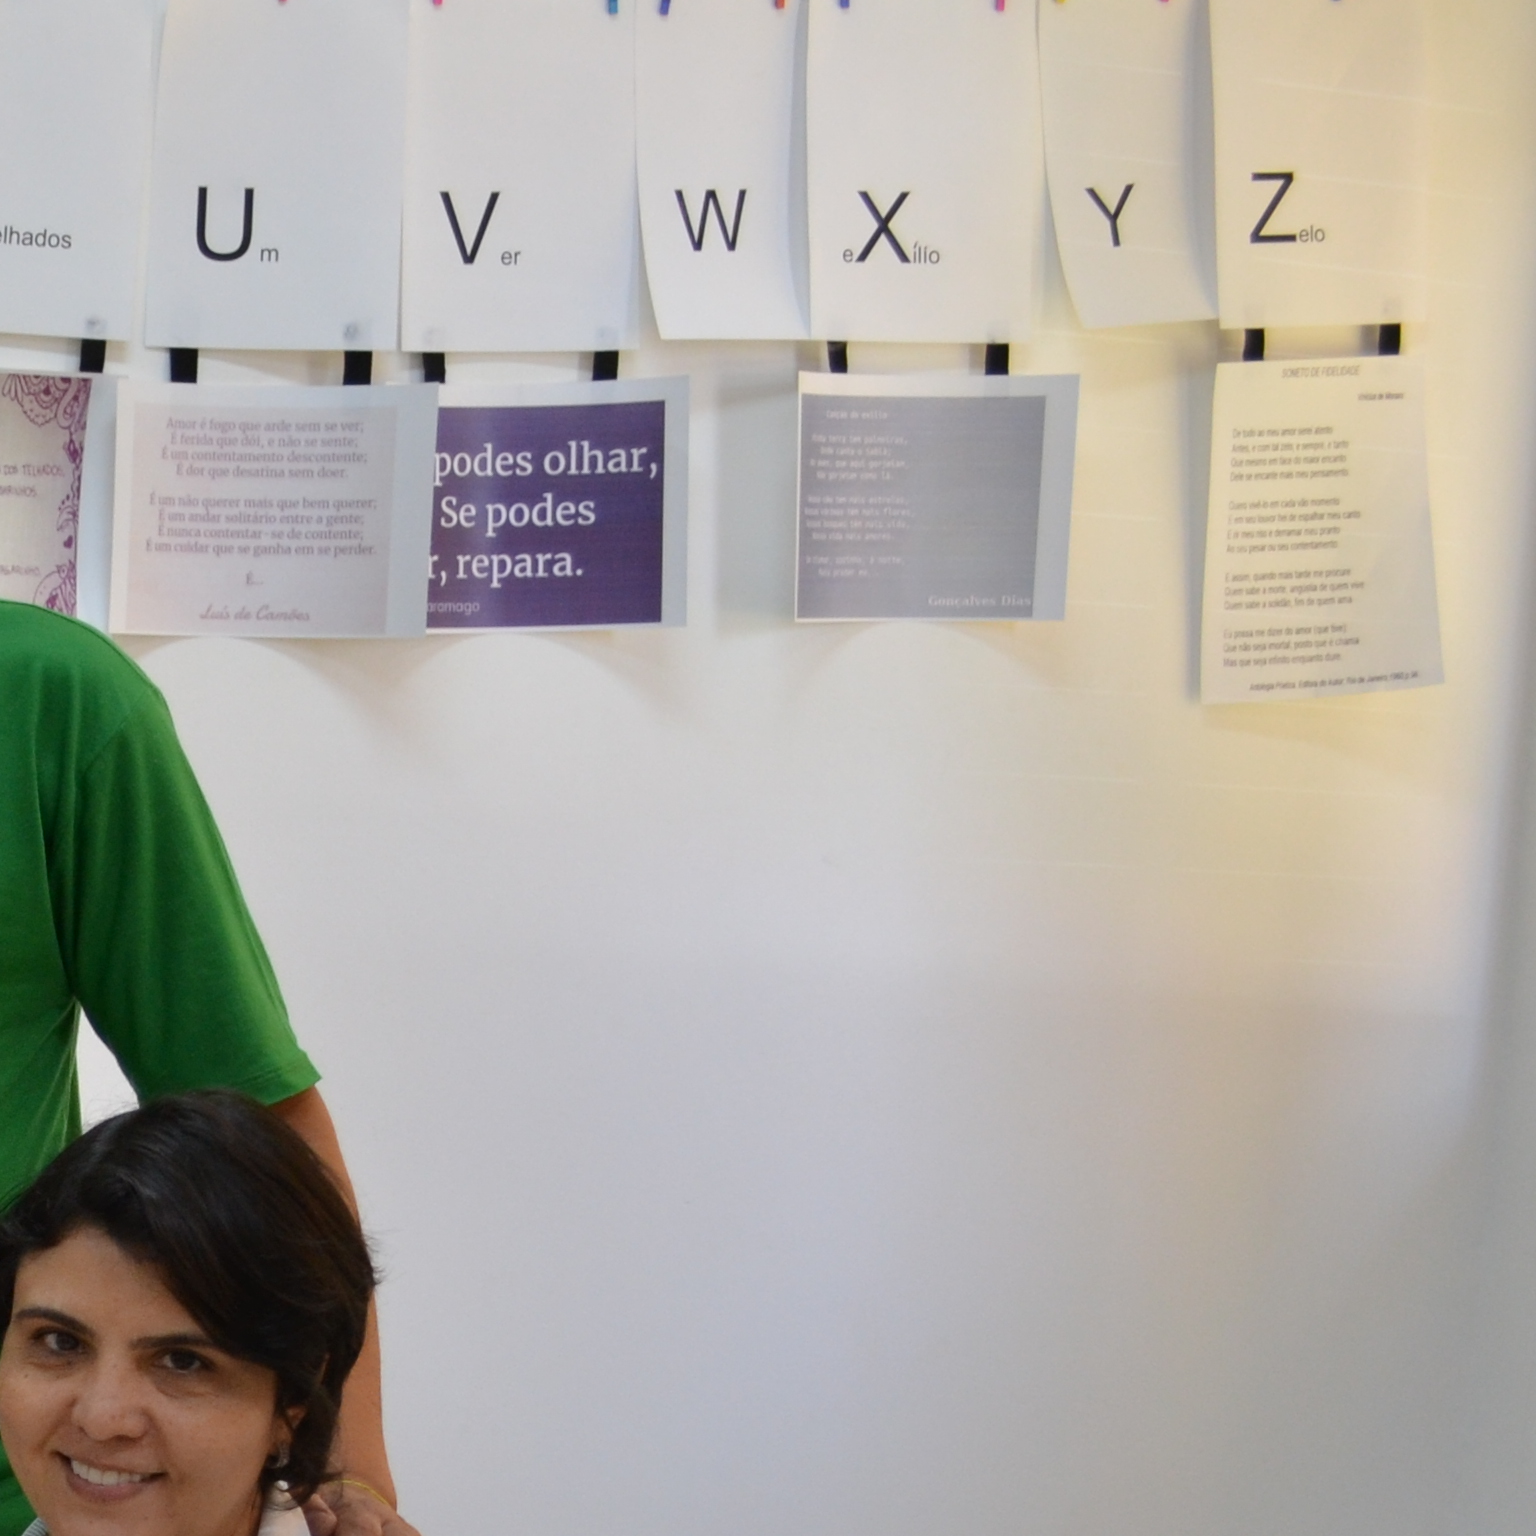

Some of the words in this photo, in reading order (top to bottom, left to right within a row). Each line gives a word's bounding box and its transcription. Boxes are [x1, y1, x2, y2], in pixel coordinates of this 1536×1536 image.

[674, 188, 747, 252] W
[1085, 183, 1135, 247] Y
[433, 442, 533, 487] podes
[543, 440, 658, 480] olhar,
[440, 495, 476, 528] Se
[485, 492, 596, 537] podes
[456, 551, 584, 588] repara.
